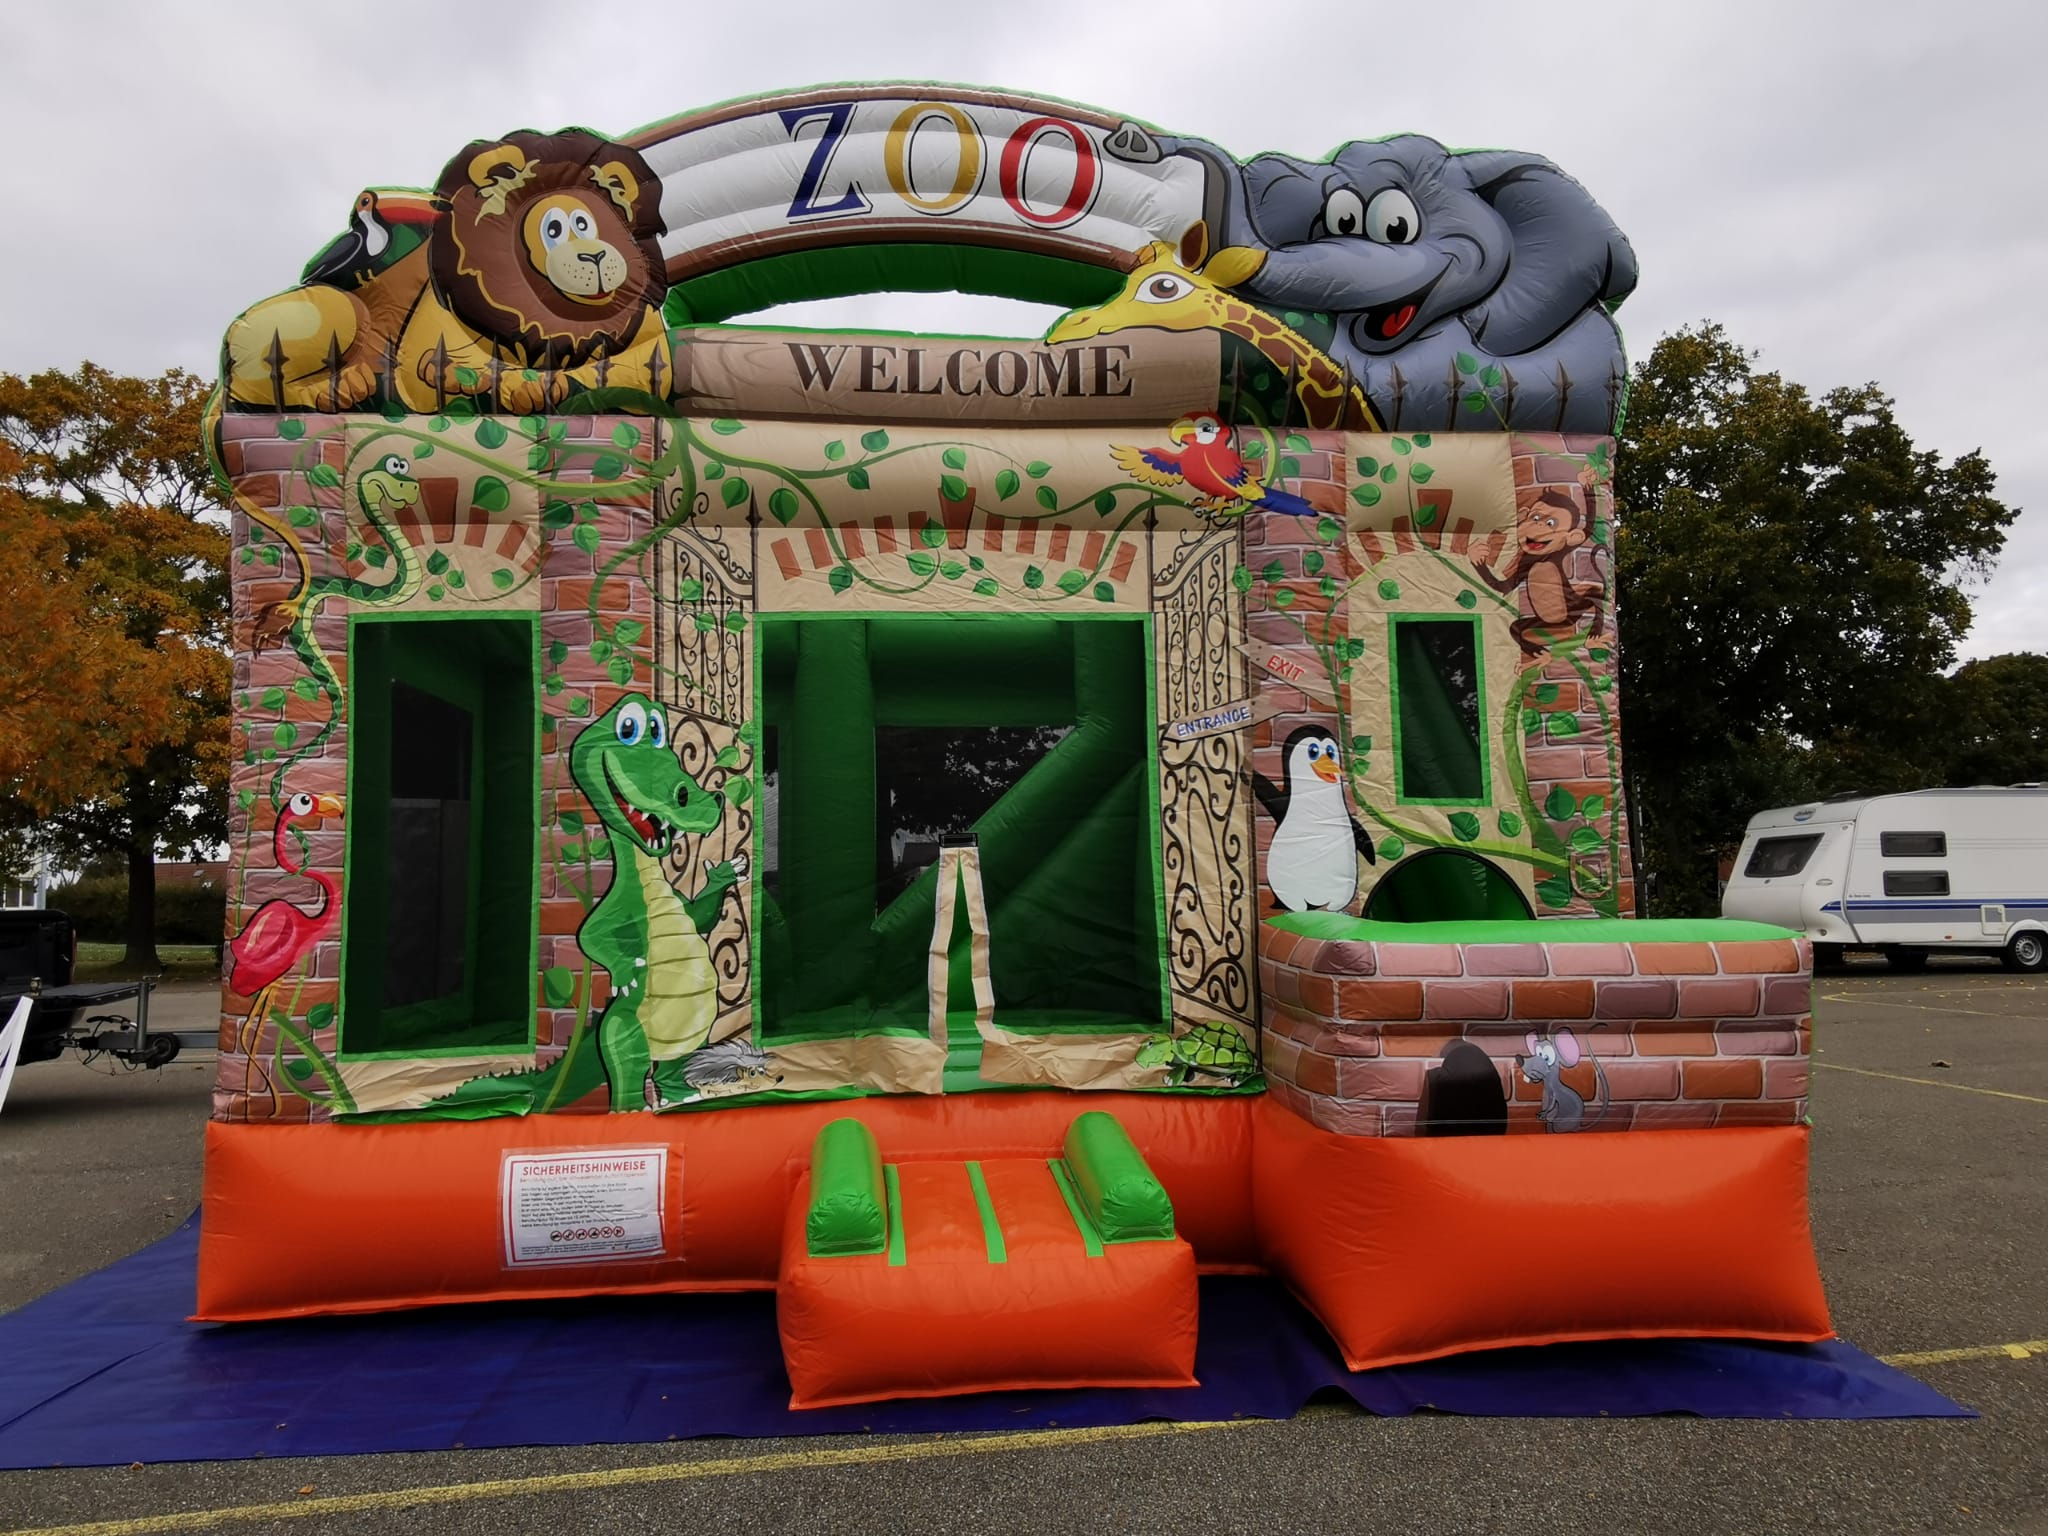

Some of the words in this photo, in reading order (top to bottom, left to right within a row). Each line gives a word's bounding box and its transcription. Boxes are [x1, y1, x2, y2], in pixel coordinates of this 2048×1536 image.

[778, 102, 1102, 229] ZOO
[782, 340, 1134, 399] WELCOME
[1266, 655, 1305, 682] EXIT
[1176, 706, 1251, 737] ENTRANCE
[522, 1160, 647, 1176] SICHERHEITSHINWEISE
